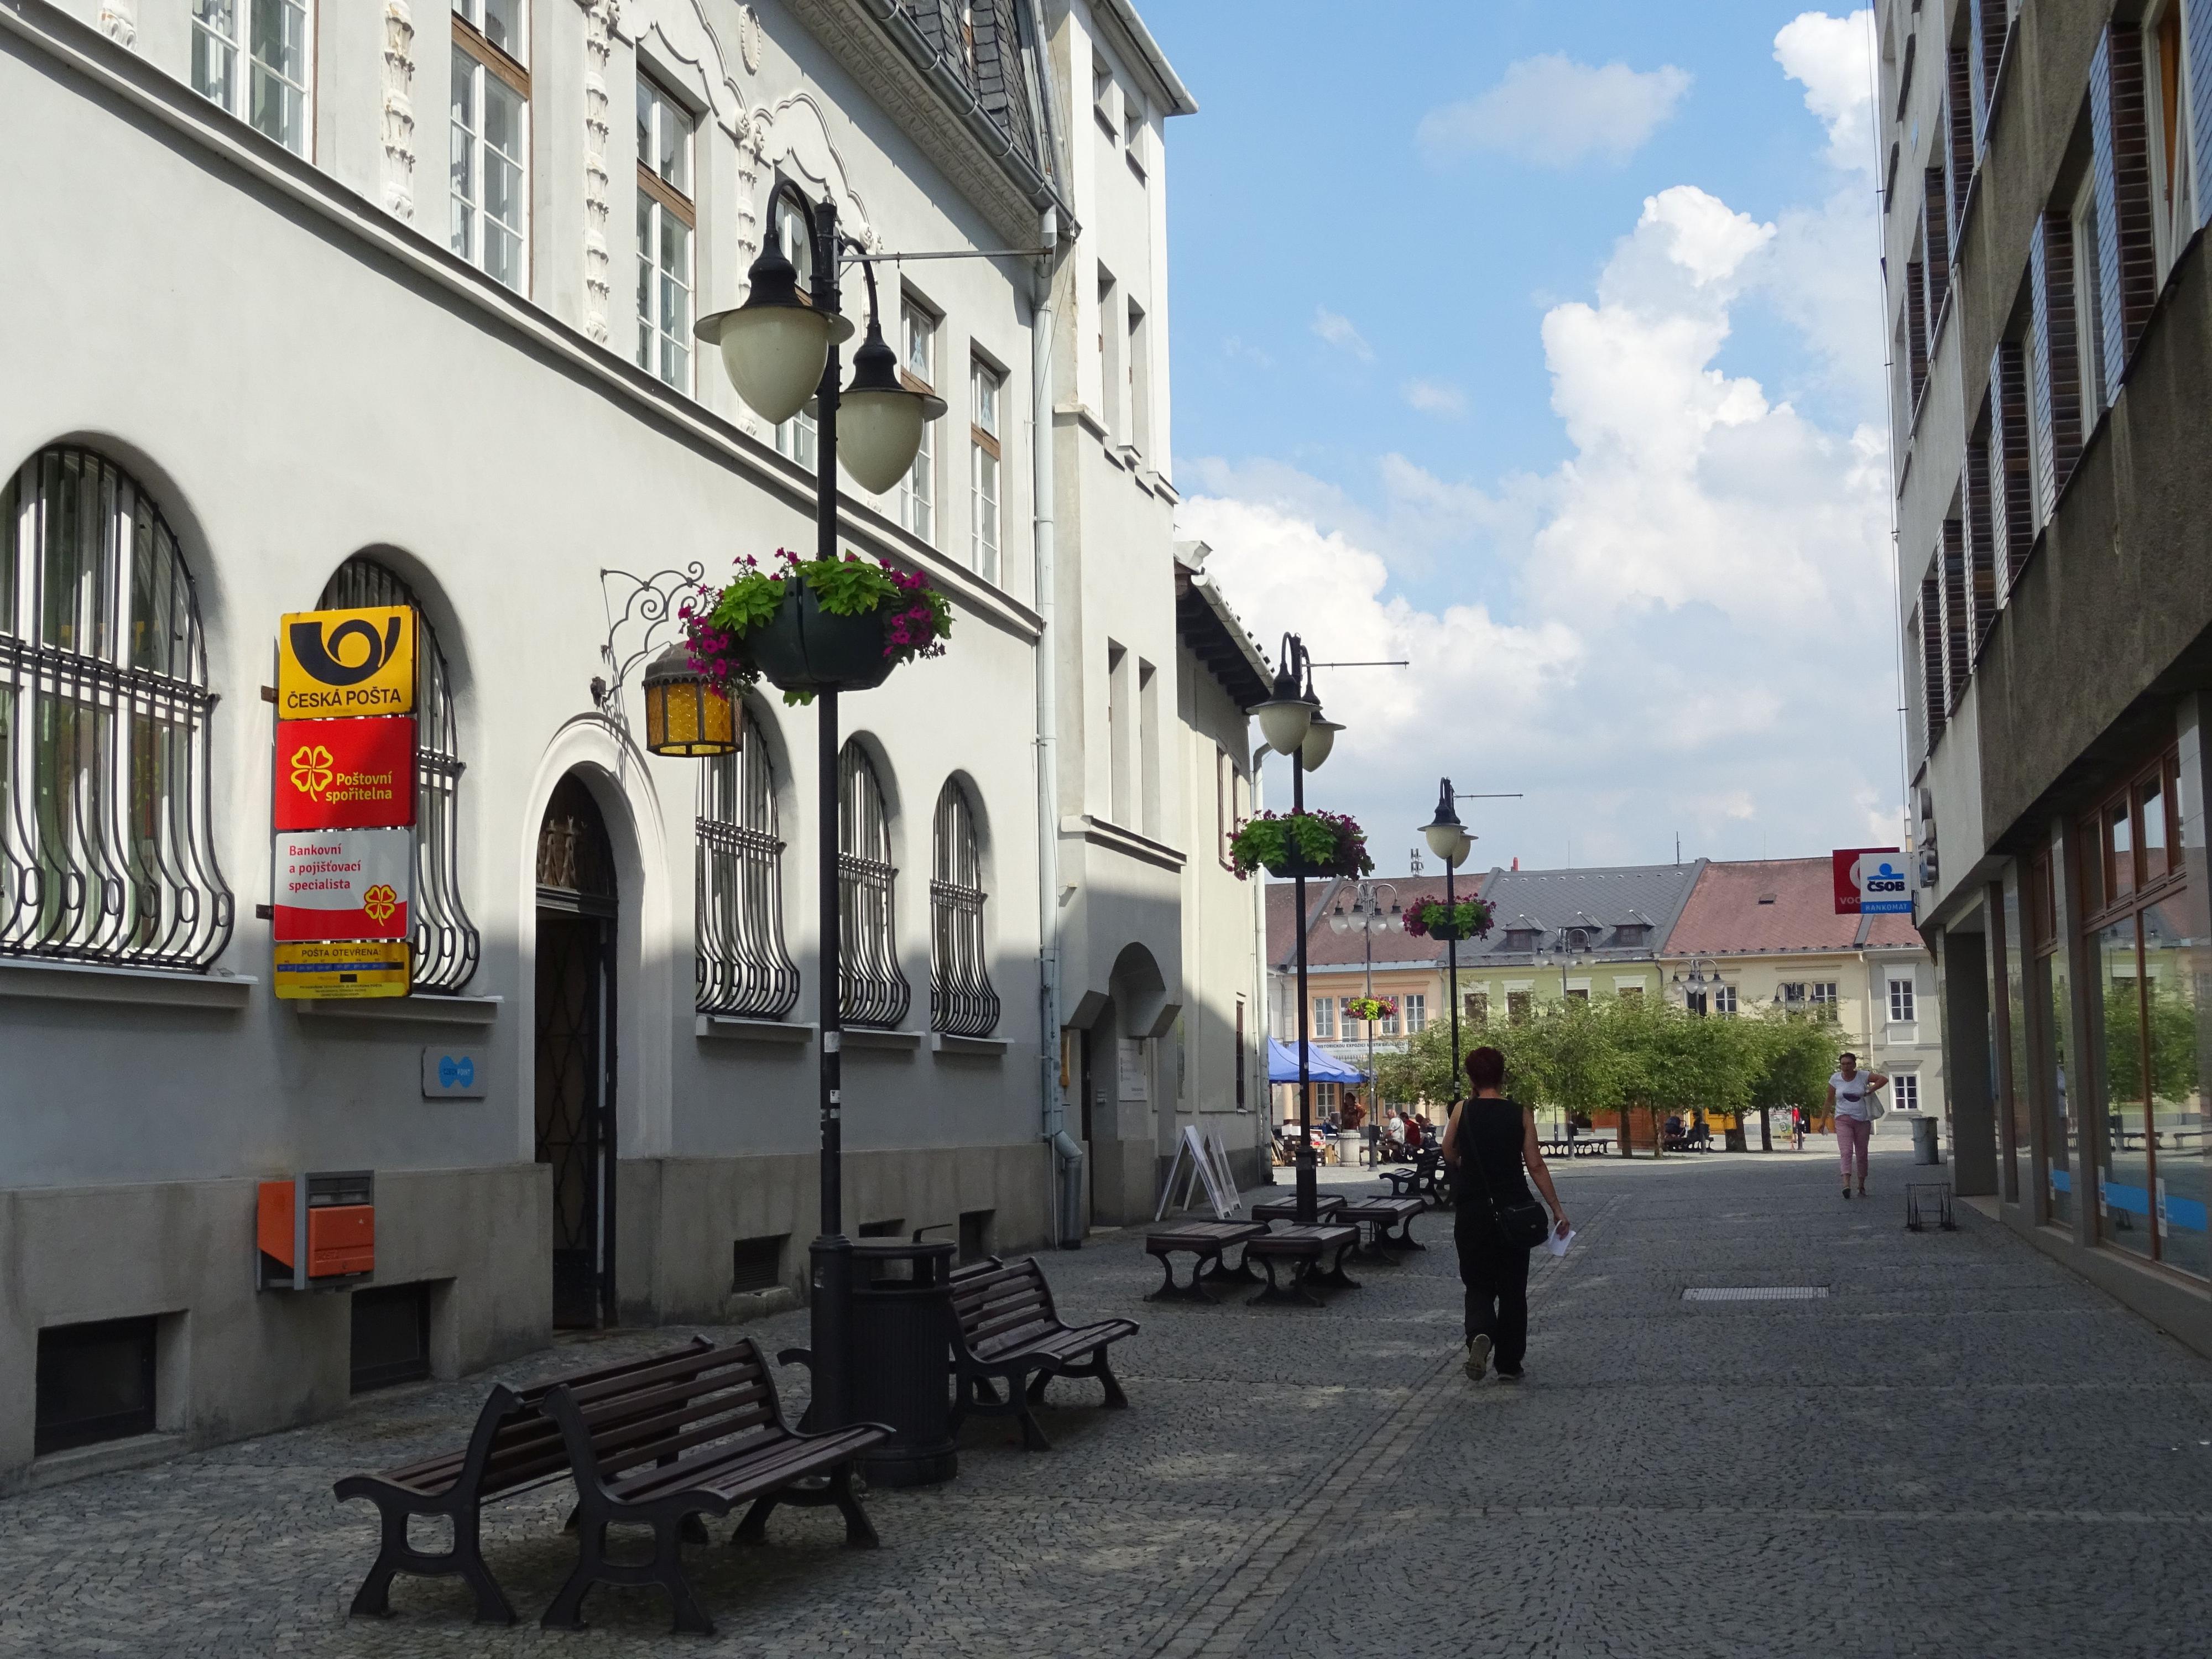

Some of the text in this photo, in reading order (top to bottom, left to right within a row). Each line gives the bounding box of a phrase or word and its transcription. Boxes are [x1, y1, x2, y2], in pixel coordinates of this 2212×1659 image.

[287, 686, 401, 709] ČESKÁ POŠTA
[336, 770, 392, 786] Poštovní
[325, 786, 392, 805] spořitelna
[289, 843, 342, 856] Bankovní
[289, 859, 362, 876] a pojišťovací
[288, 878, 351, 893] specialista
[1867, 880, 1905, 892] ČSOB
[1865, 903, 1907, 911] BANKOMAT
[301, 946, 382, 957] POŠTA OTEVŘENA:
